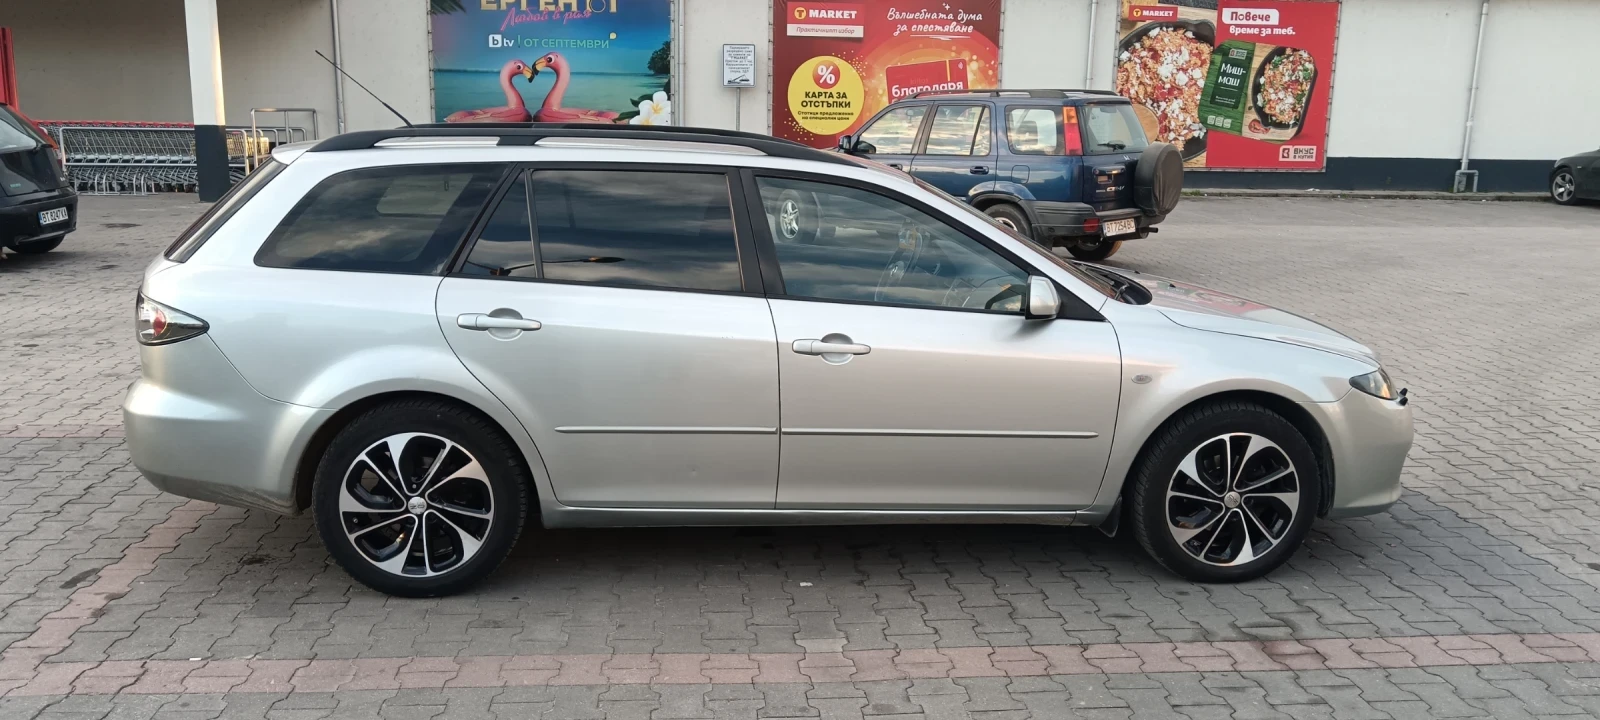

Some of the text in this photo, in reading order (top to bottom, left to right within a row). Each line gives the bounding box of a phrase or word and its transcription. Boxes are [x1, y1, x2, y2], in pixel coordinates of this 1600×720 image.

[500, 7, 549, 31] Любов
[552, 6, 561, 20] в
[808, 9, 858, 19] MARKET
[886, 7, 983, 23] Вълшебната дума
[1230, 11, 1271, 22] Повече
[893, 22, 974, 36] за спестяване
[1229, 25, 1296, 37] време за теб.
[523, 38, 610, 49] ОТ СЕПТЕМВРИ
[817, 64, 836, 85] %
[804, 91, 848, 99] КАРТА ЗА
[800, 100, 851, 109] ОТСТЪПКИ
[1293, 147, 1315, 155] ВКУС
